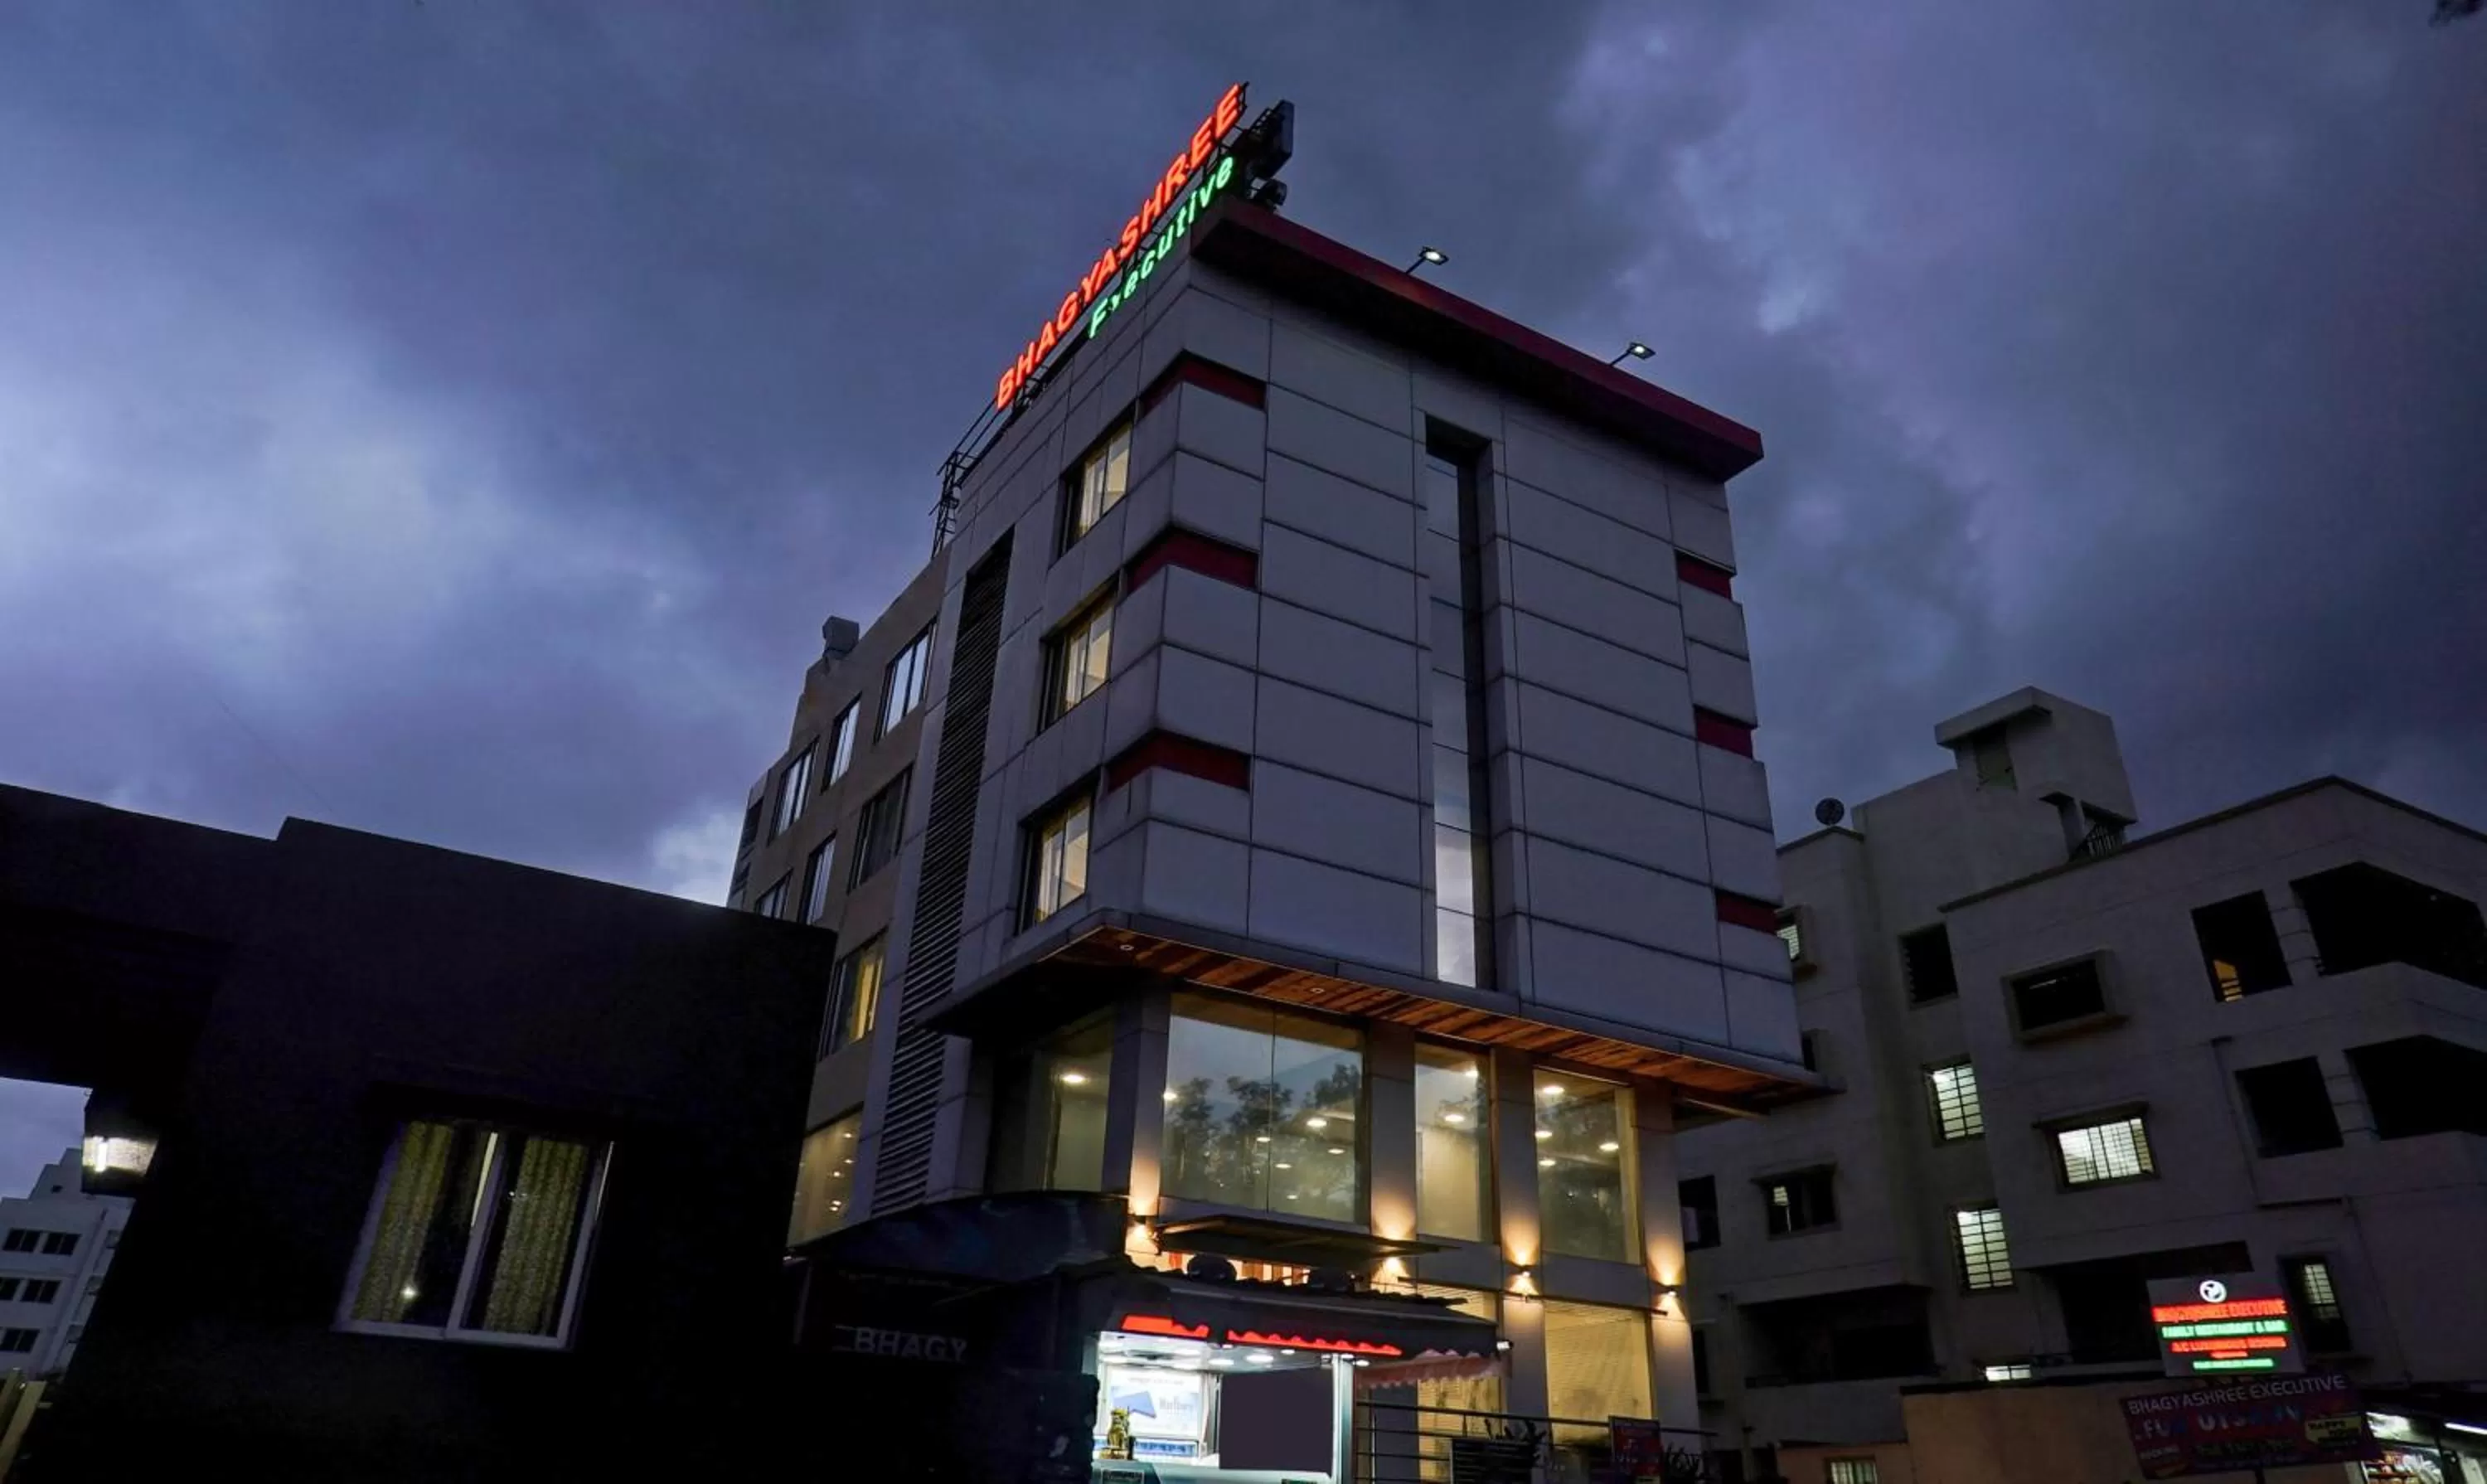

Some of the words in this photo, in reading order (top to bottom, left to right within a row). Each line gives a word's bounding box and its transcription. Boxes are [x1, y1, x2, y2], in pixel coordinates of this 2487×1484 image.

[996, 82, 1241, 410] BHAGYASHREE
[854, 1326, 967, 1362] BHAGY
[2126, 1385, 2246, 1415] BHAGYASHREE
[2250, 1374, 2348, 1399] EXECUTIVE
